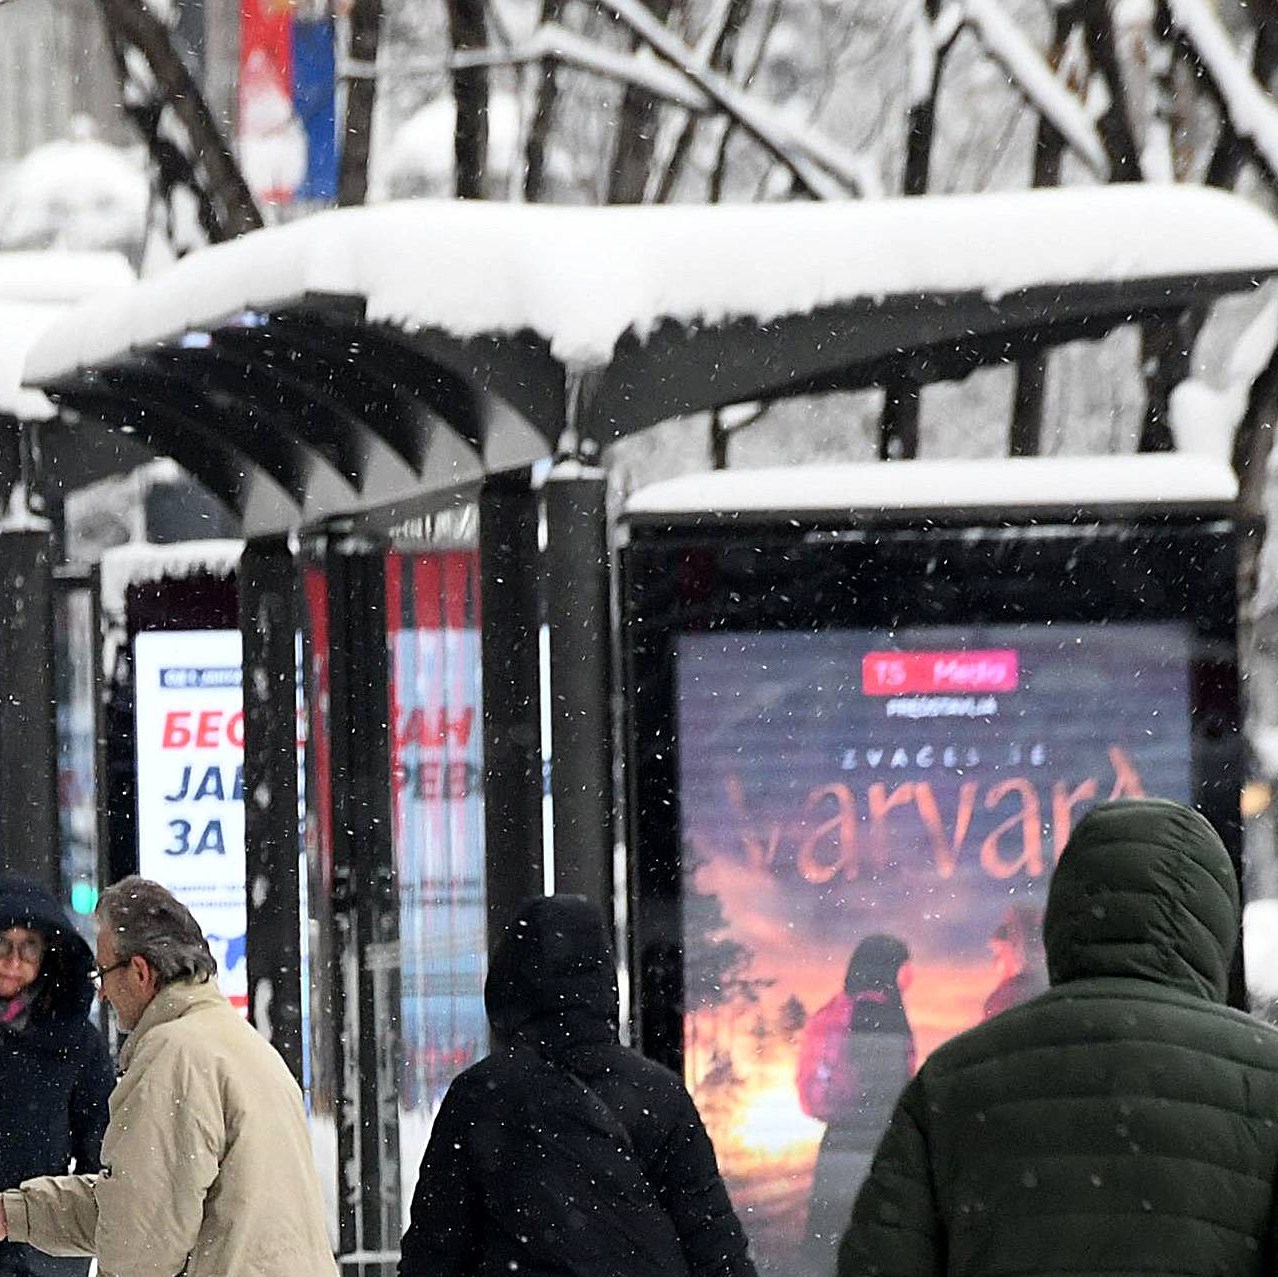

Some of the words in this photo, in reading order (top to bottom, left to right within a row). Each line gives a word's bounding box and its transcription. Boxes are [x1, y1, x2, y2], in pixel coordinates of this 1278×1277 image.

[162, 711, 246, 750] БЕС
[725, 743, 1147, 884] arvar
[164, 820, 227, 856] ЗА
